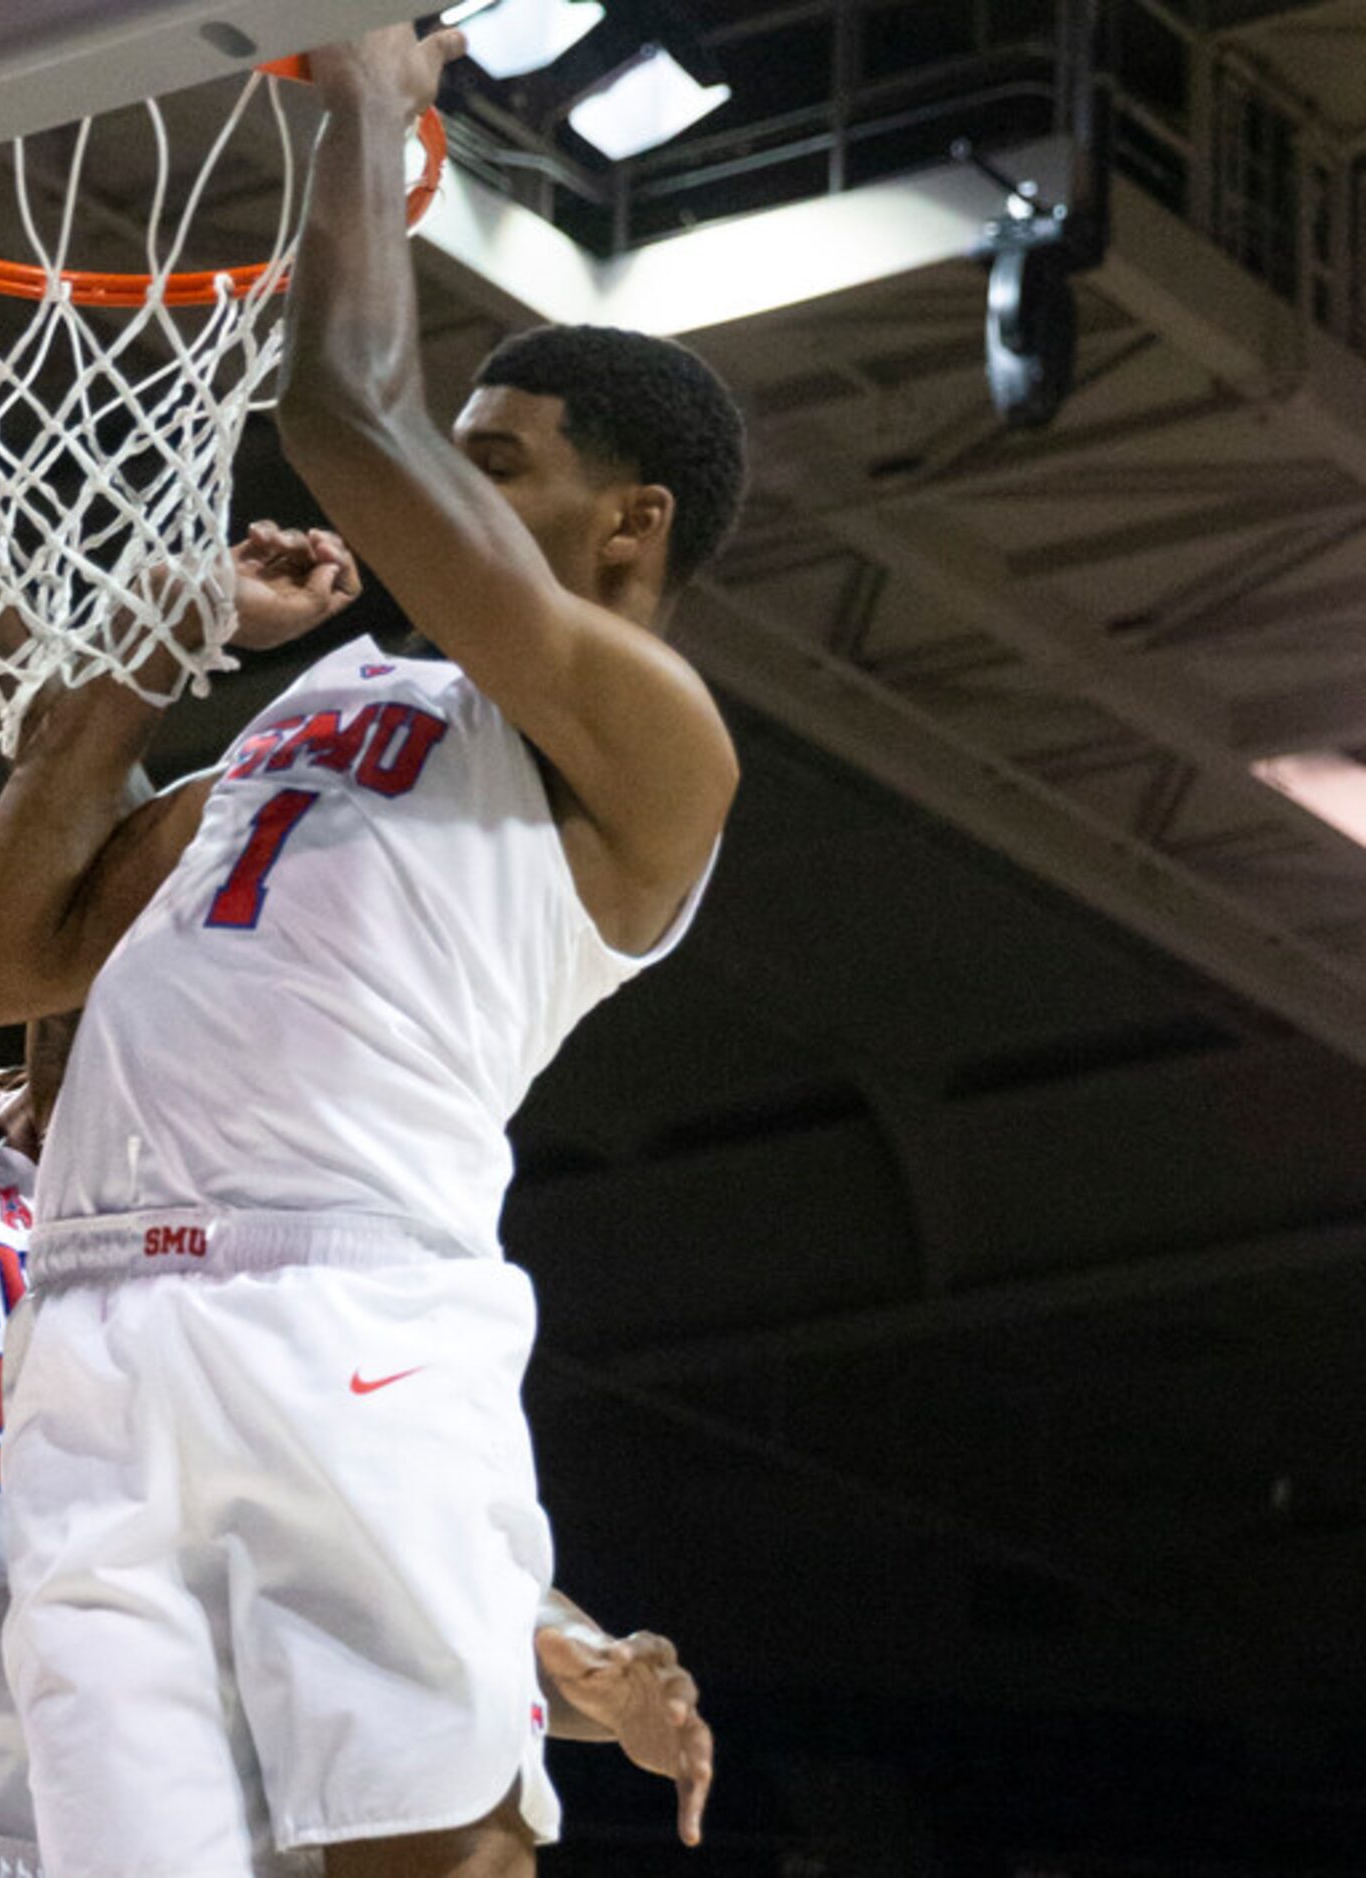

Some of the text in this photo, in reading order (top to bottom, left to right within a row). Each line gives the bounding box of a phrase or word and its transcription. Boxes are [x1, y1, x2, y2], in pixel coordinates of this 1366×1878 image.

[226, 701, 449, 799] SMU
[203, 787, 321, 930] 1
[143, 1225, 207, 1257] SMU
